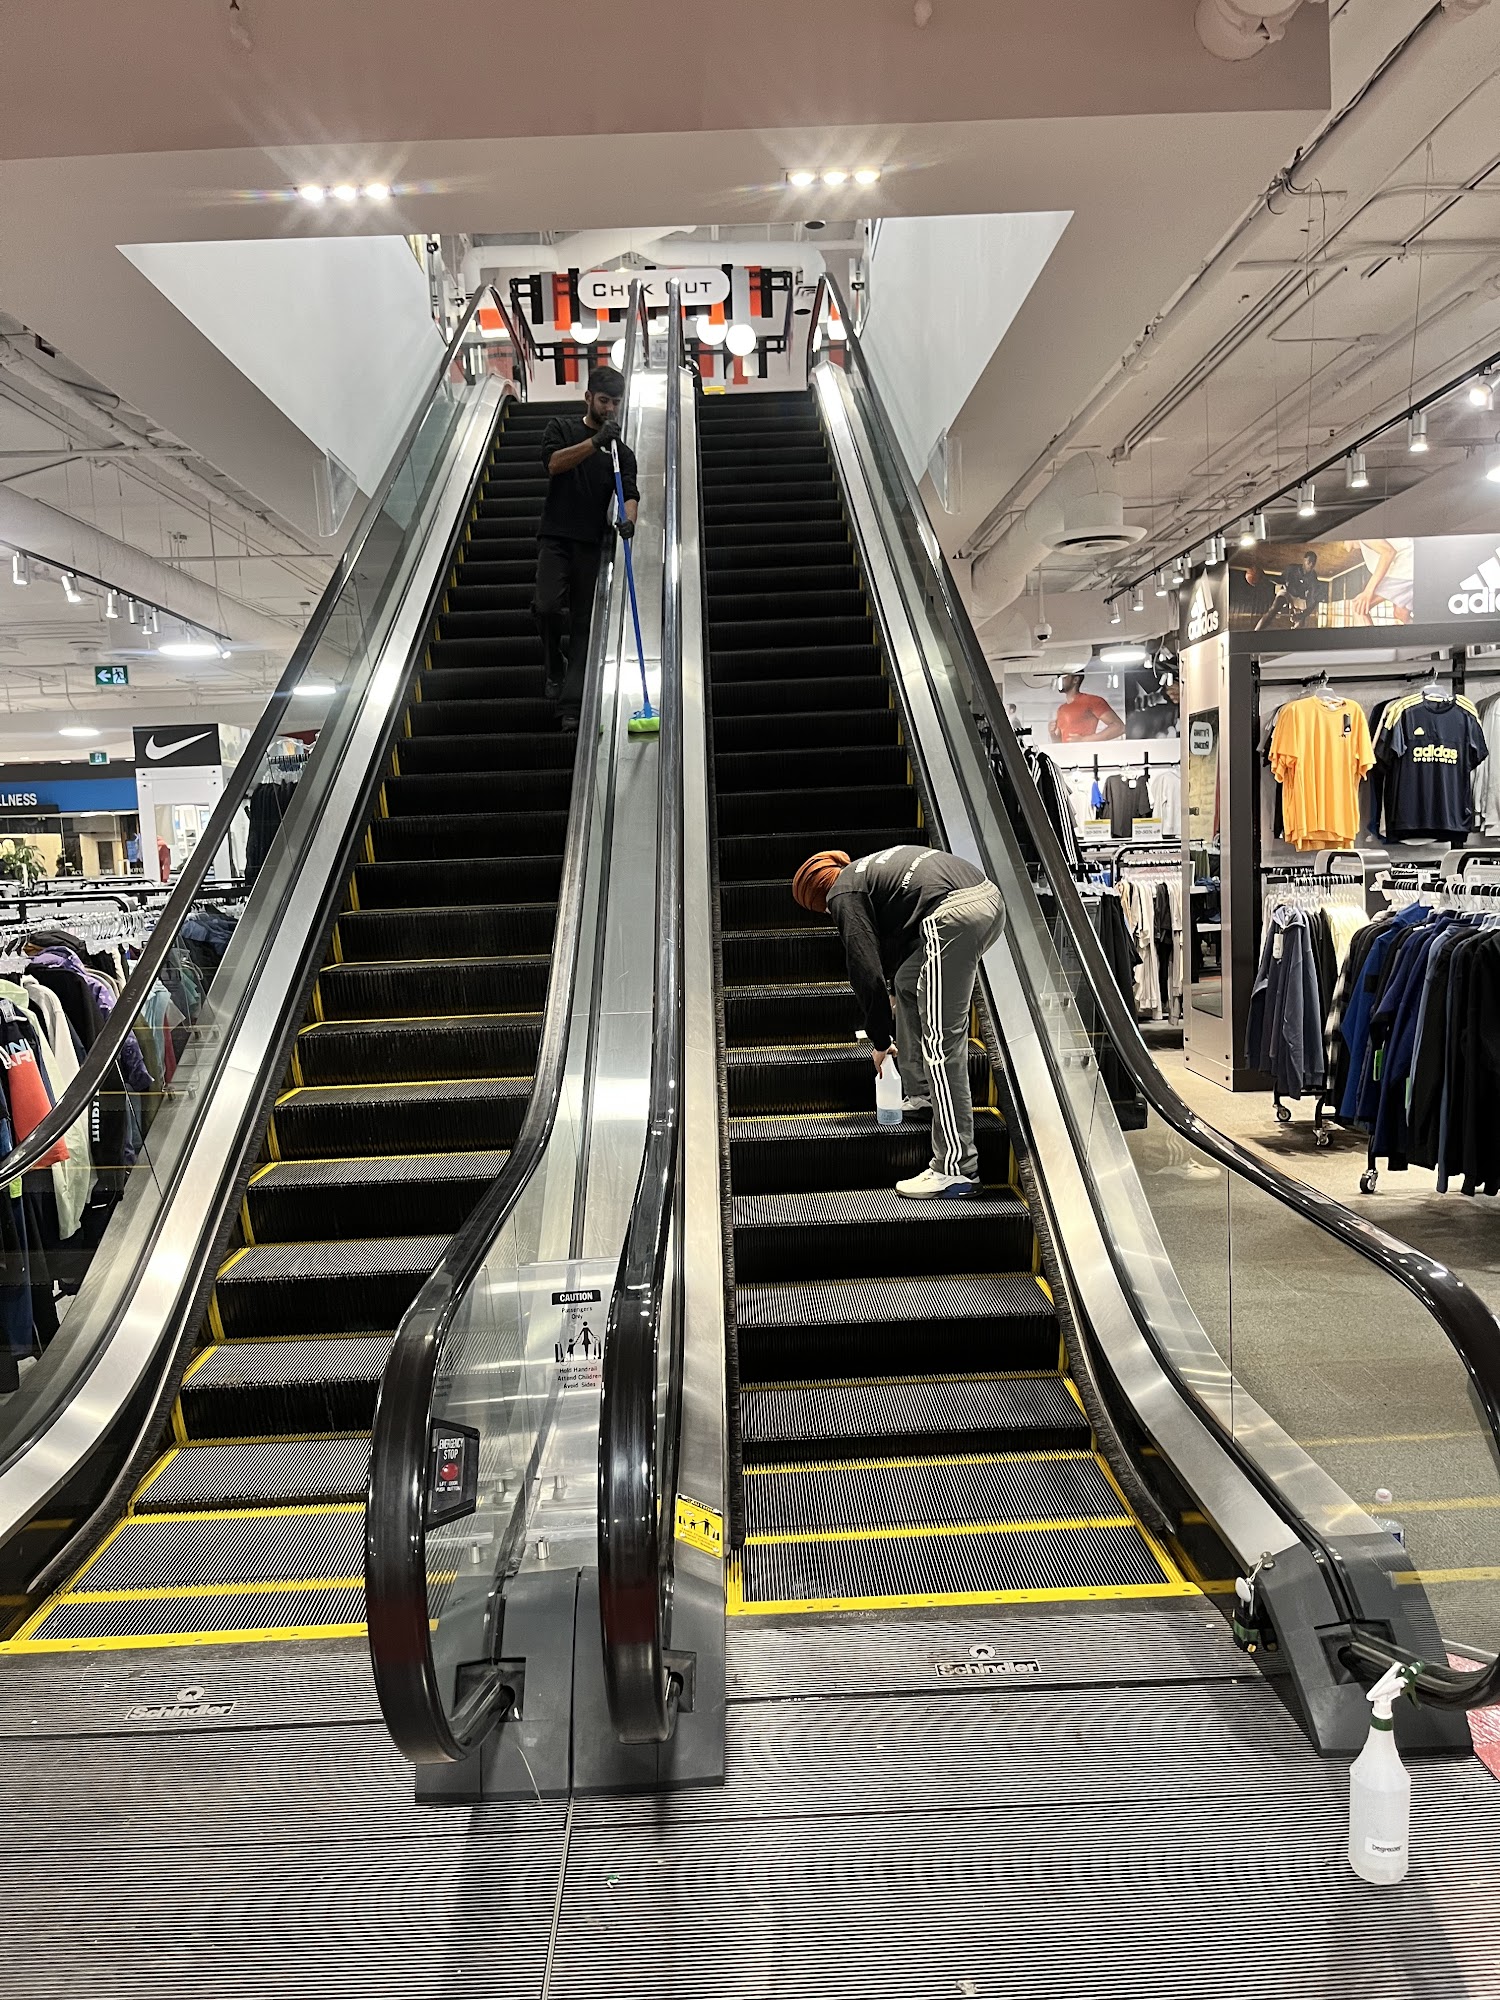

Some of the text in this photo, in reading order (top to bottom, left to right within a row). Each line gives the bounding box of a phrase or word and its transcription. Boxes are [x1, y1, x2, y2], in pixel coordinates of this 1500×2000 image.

[593, 283, 654, 297] CHK
[1188, 609, 1219, 641] adidas
[1413, 744, 1458, 760] adidas
[0, 793, 38, 806] LNESS
[560, 1291, 593, 1302] CAUTION
[438, 1438, 464, 1450] EMERGENCY
[443, 1449, 459, 1460] STOP
[938, 1661, 1037, 1675] Schindler
[129, 1704, 232, 1719] Schindler
